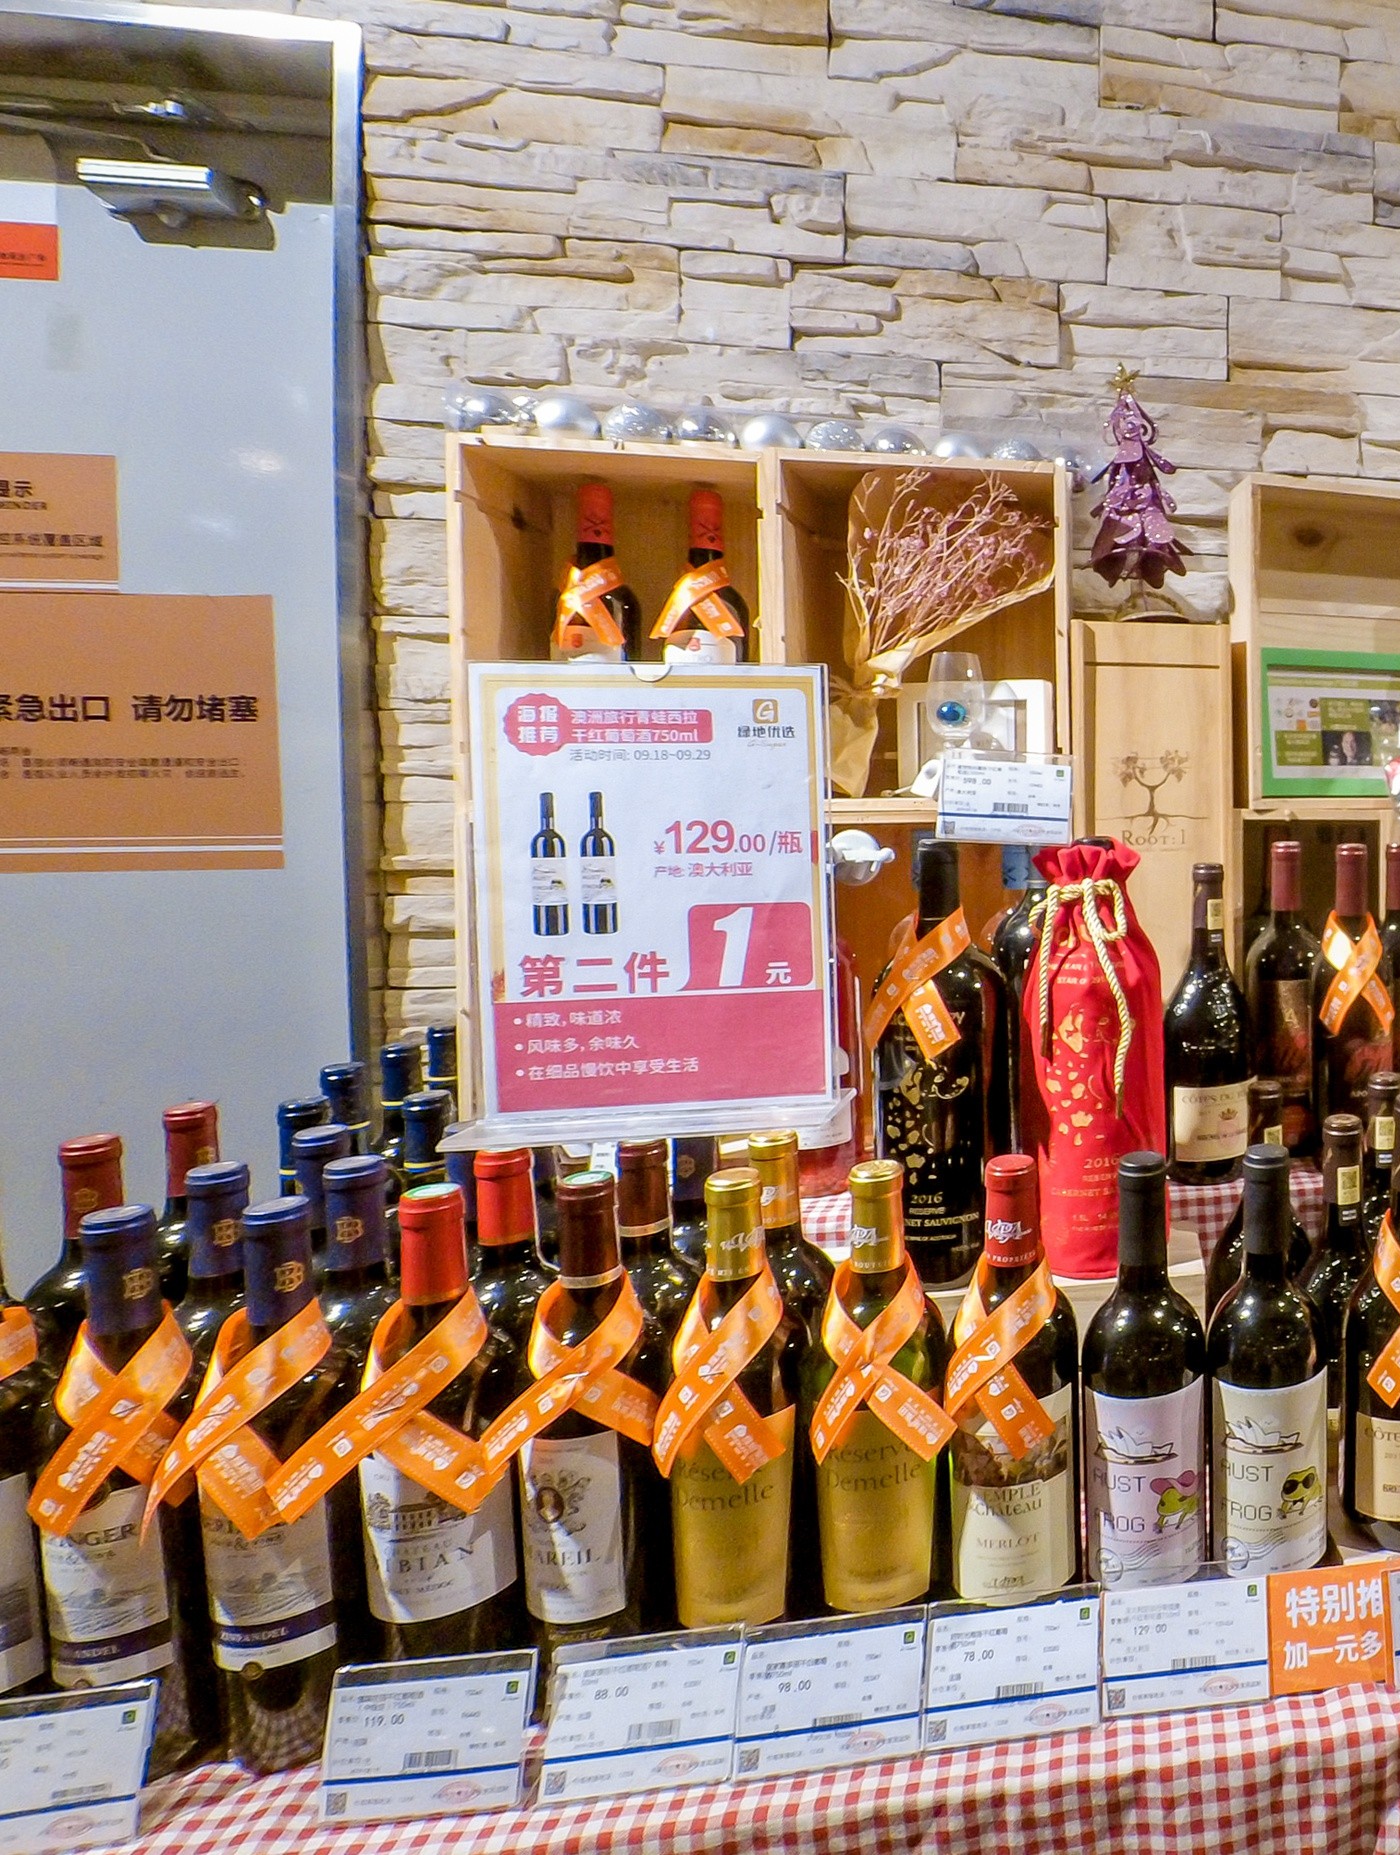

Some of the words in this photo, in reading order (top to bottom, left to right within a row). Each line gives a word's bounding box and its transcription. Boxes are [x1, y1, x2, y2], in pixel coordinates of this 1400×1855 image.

[131, 695, 259, 723] 请勿堵塞
[570, 709, 699, 725] 澳洲旅行青蛙西拉
[517, 726, 559, 744] 推荐
[571, 728, 699, 743] 干红葡萄酒750ml
[737, 726, 796, 739] 绿地优选
[633, 750, 712, 761] 09.18~09.29
[688, 861, 754, 878] 澳大利亚
[518, 951, 672, 999] 第二件
[713, 906, 755, 988] 1
[765, 962, 792, 985] 元
[528, 1058, 699, 1081] 在细品慢饮中享受生活
[910, 1191, 944, 1205] 2016
[923, 1210, 981, 1227] SAUVIGNON
[826, 1461, 923, 1493] Demelle
[676, 1483, 775, 1511] Demelle
[975, 1533, 1041, 1550] MERLOT
[963, 1649, 995, 1662] 78.00
[1284, 1630, 1385, 1671] 加一元多
[778, 1679, 812, 1693] 98.00
